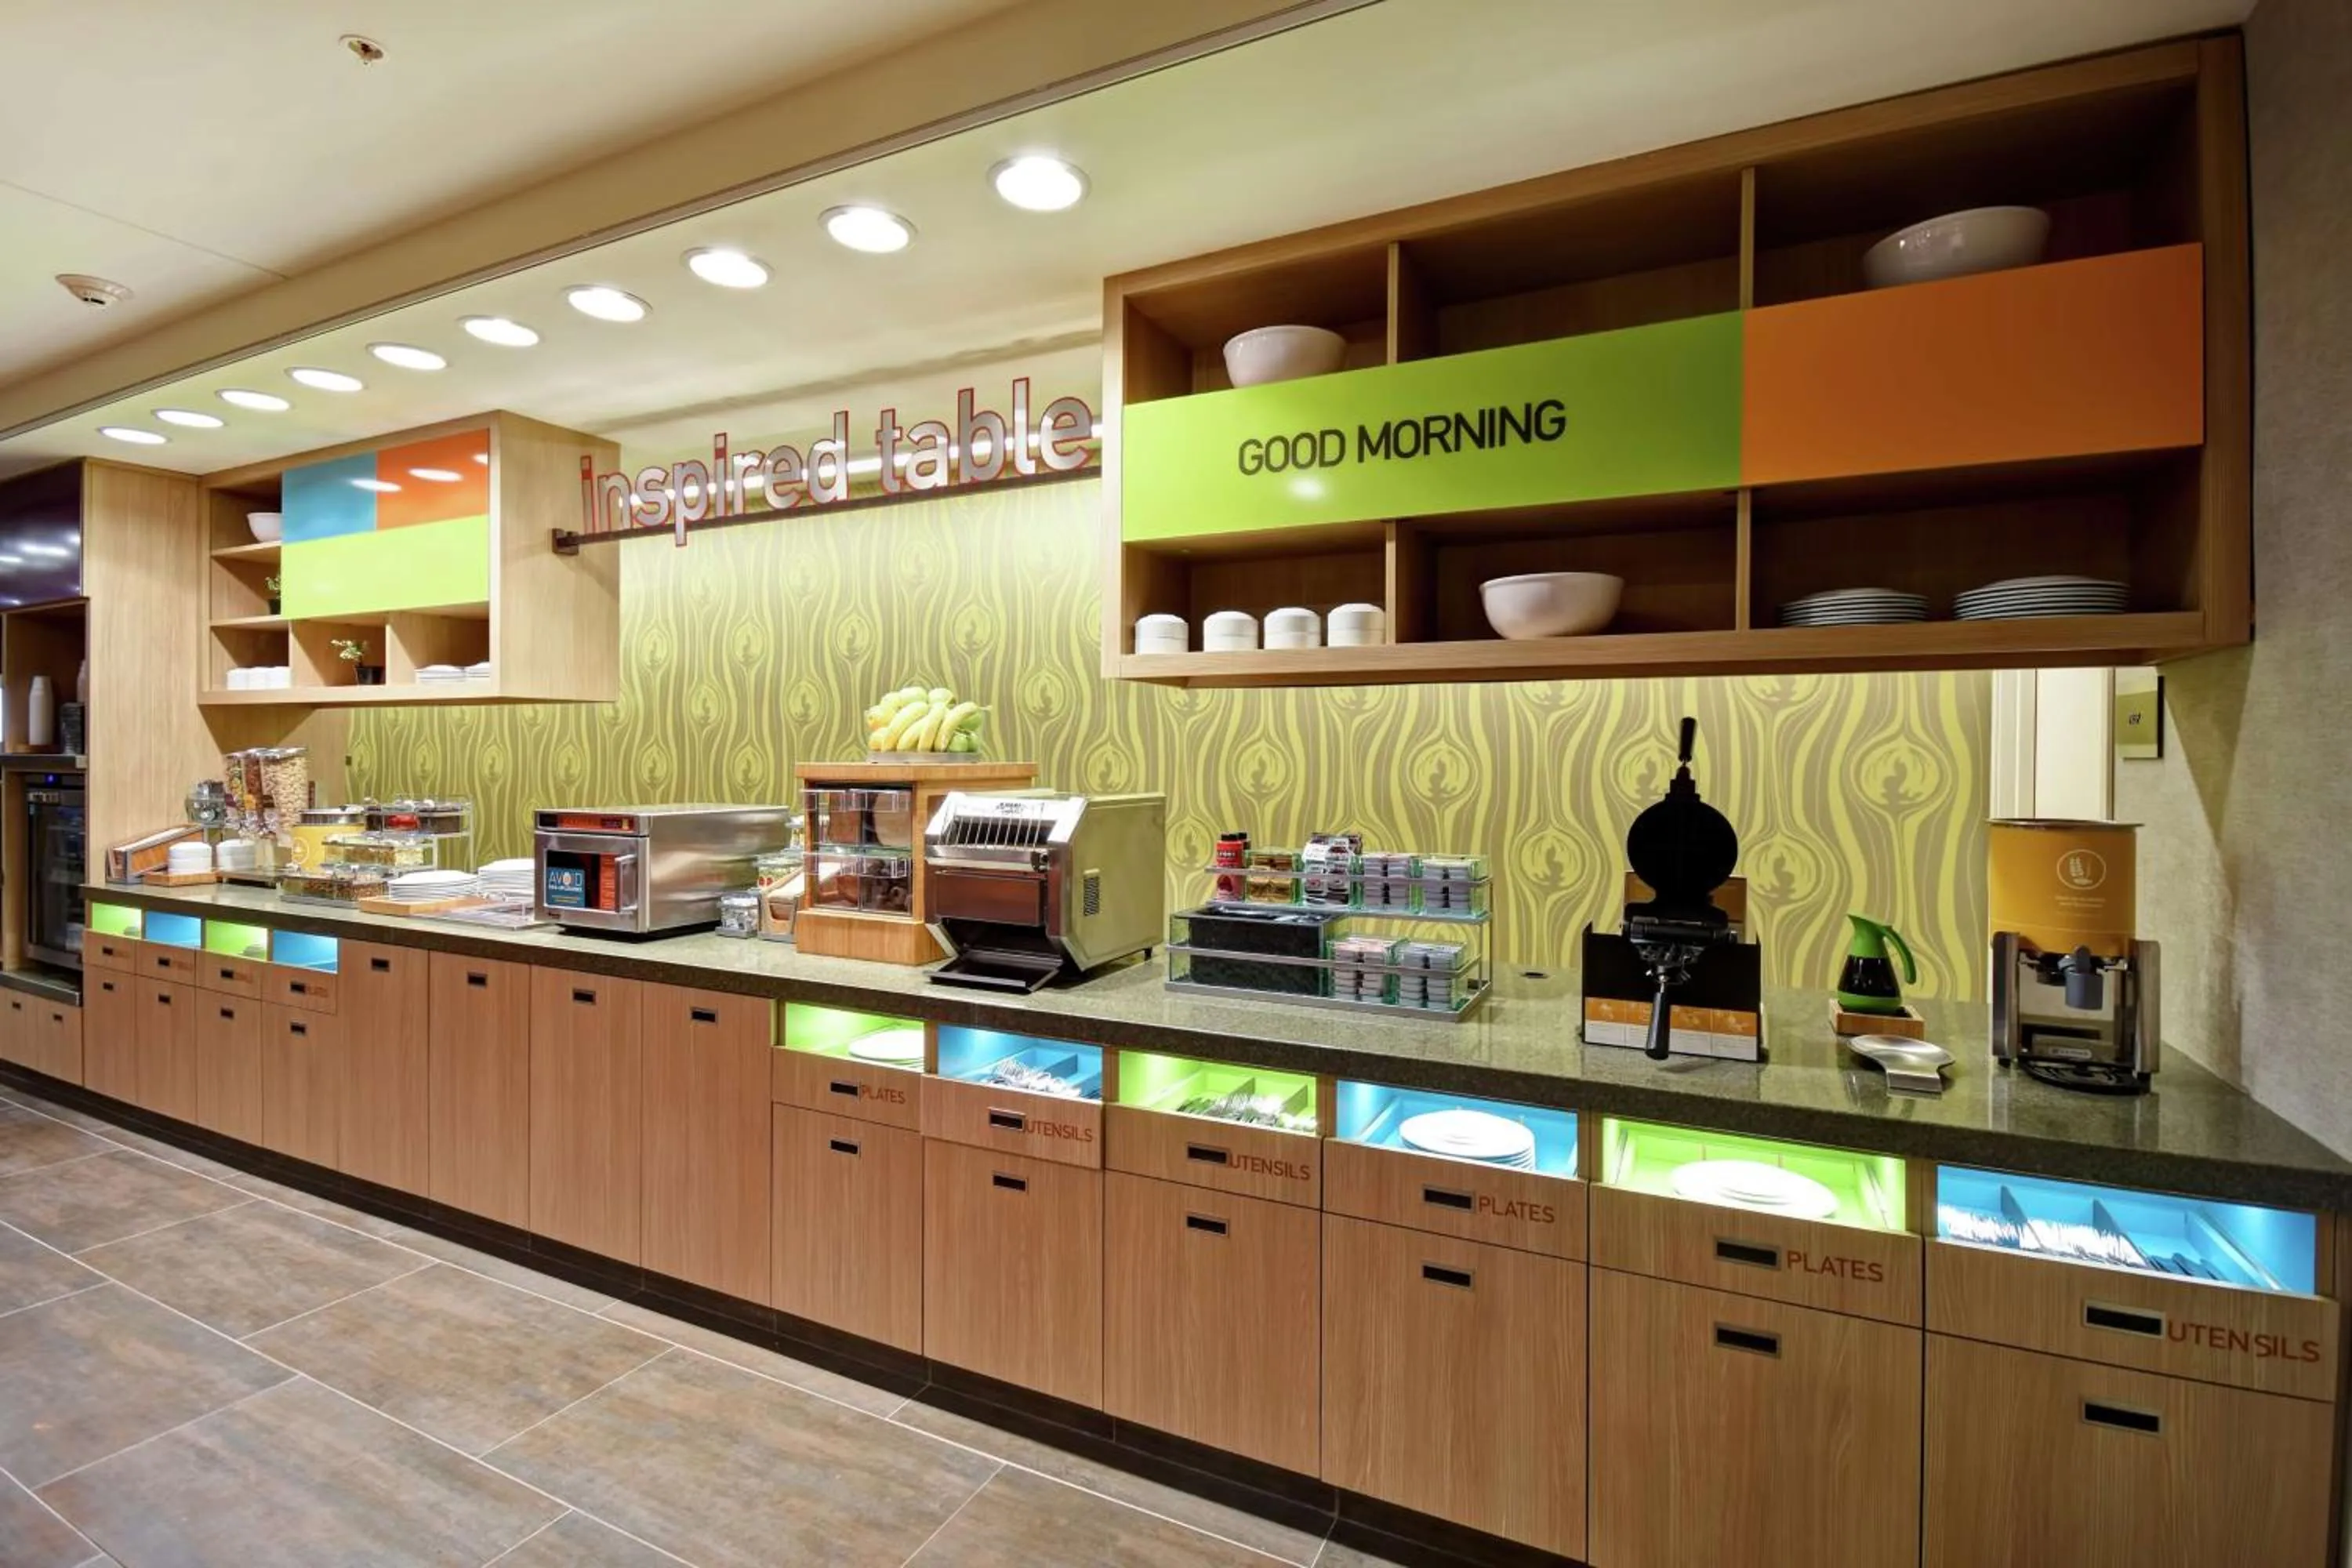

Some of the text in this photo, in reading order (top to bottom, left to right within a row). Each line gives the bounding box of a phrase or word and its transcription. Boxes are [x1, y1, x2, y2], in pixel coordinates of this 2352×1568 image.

[1238, 399, 1566, 476] GOOD MORNING
[580, 377, 1093, 547] inspired table
[861, 1084, 906, 1105] PLATES
[1025, 1118, 1093, 1143] UTENSILS
[1229, 1152, 1311, 1181] UTENSILS
[1478, 1197, 1555, 1225] PLATES
[1786, 1250, 1883, 1283] PLATES
[2167, 1319, 2321, 1363] UTENSILS
